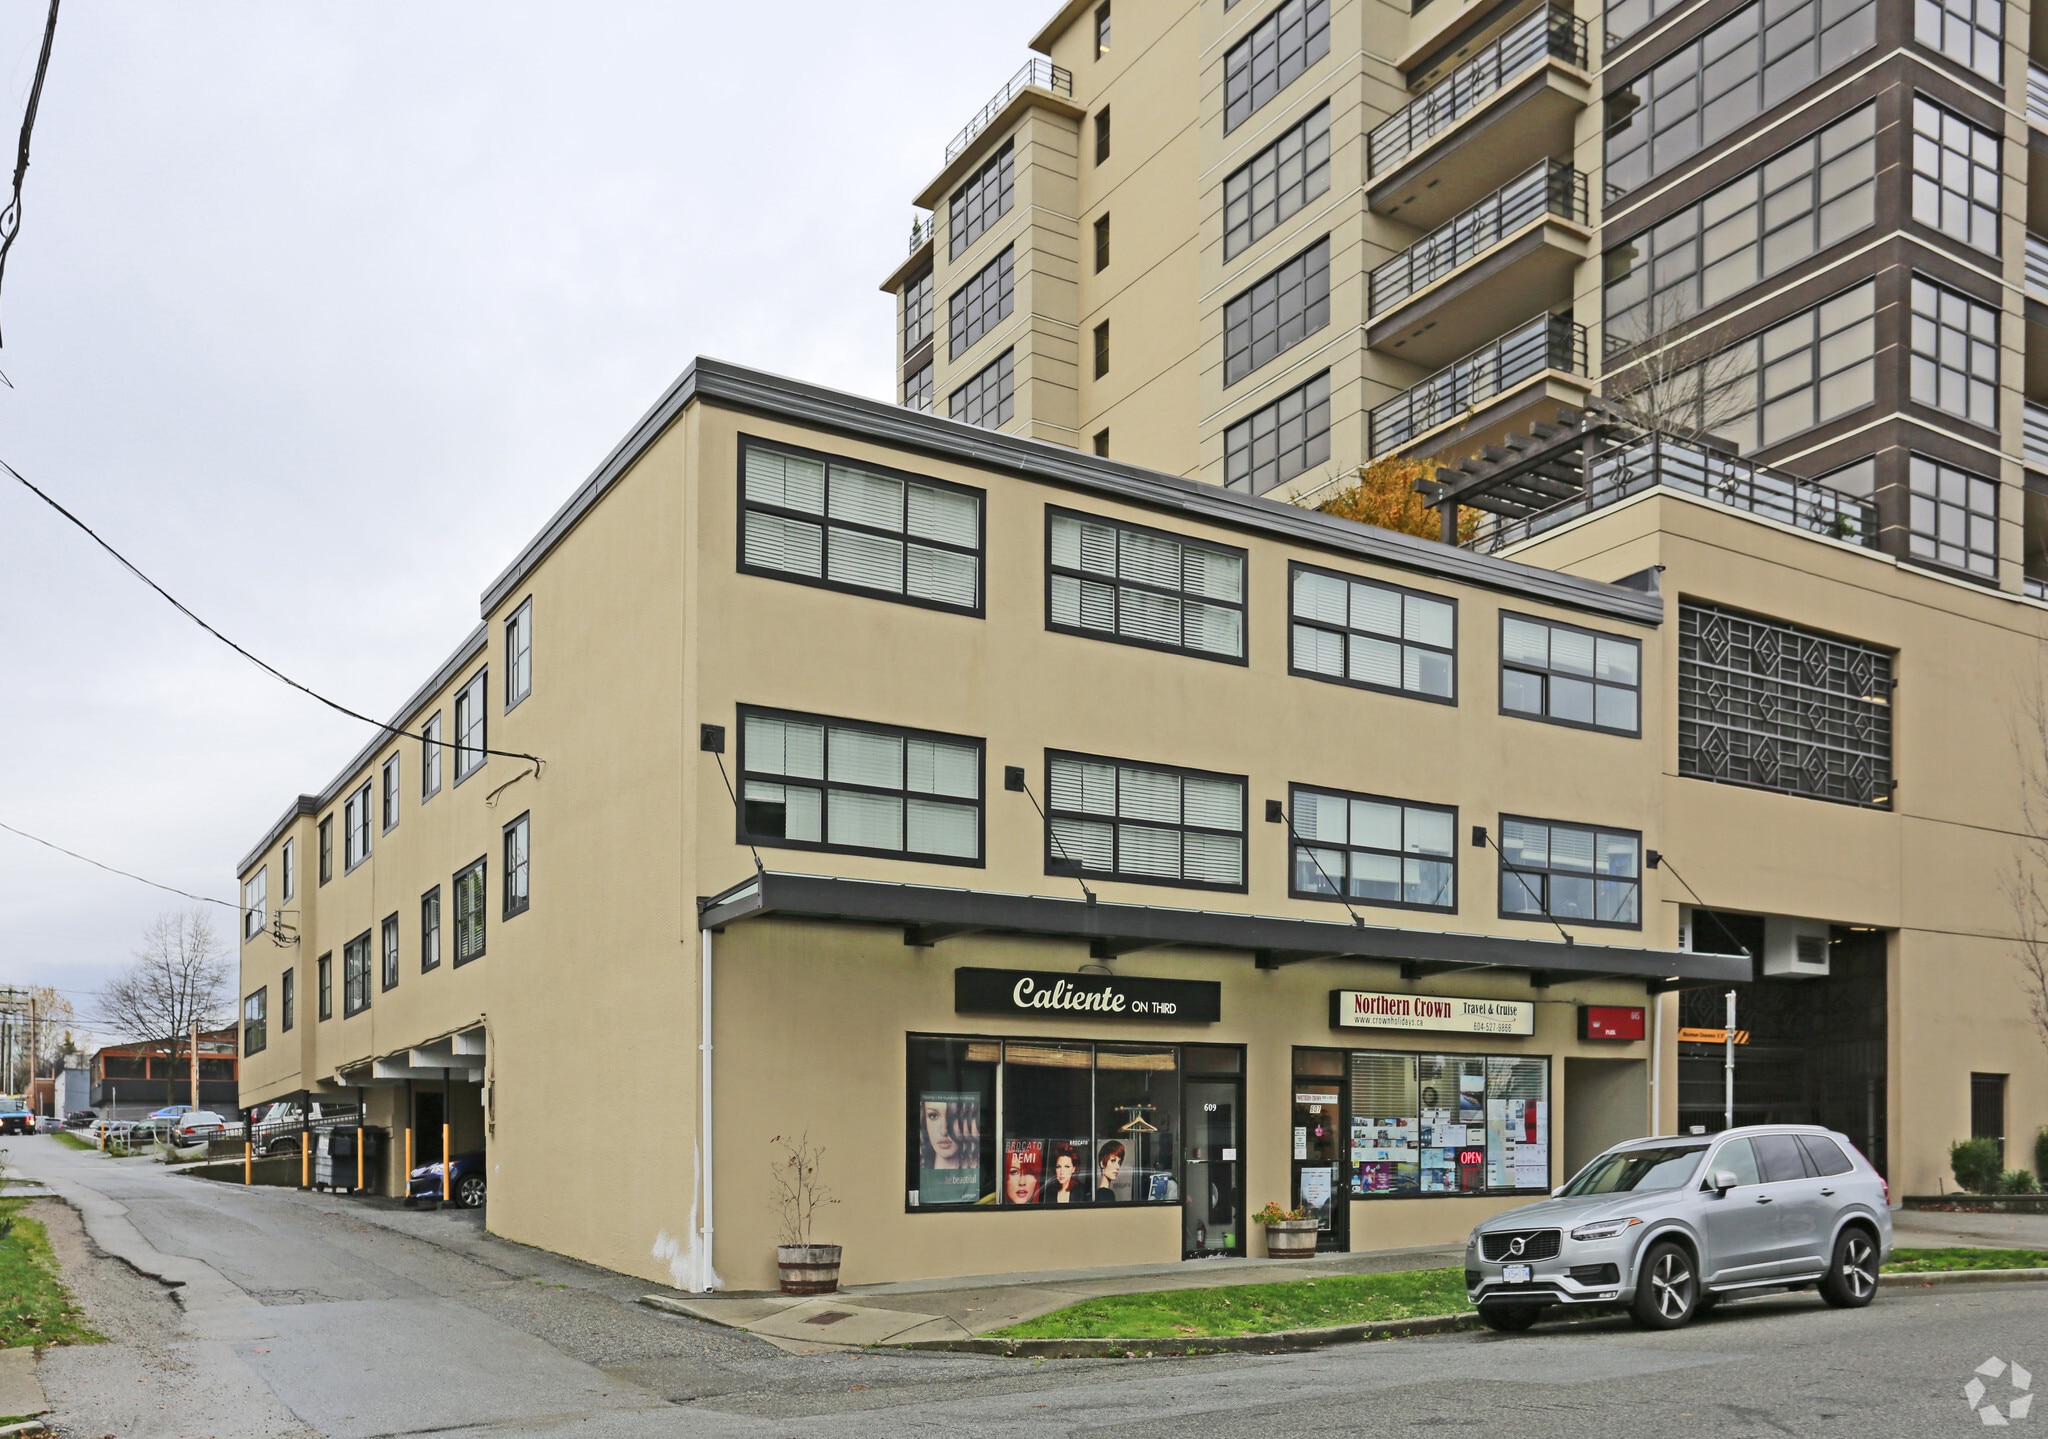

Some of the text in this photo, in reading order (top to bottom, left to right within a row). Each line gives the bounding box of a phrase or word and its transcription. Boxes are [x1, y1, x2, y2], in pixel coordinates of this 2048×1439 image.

[1013, 977, 1177, 1014] Caliente ON THIRD
[1355, 994, 1451, 1019] Northern Crown
[1463, 1002, 1518, 1016] Travel & Cruise
[1354, 1016, 1423, 1027] www.crownholidays.ca
[1204, 1103, 1217, 1111] 609
[1006, 1141, 1043, 1150] BROCATO
[1012, 1153, 1036, 1163] DEMI
[1461, 1152, 1482, 1164] OPEN
[953, 1174, 977, 1184] beautiful
